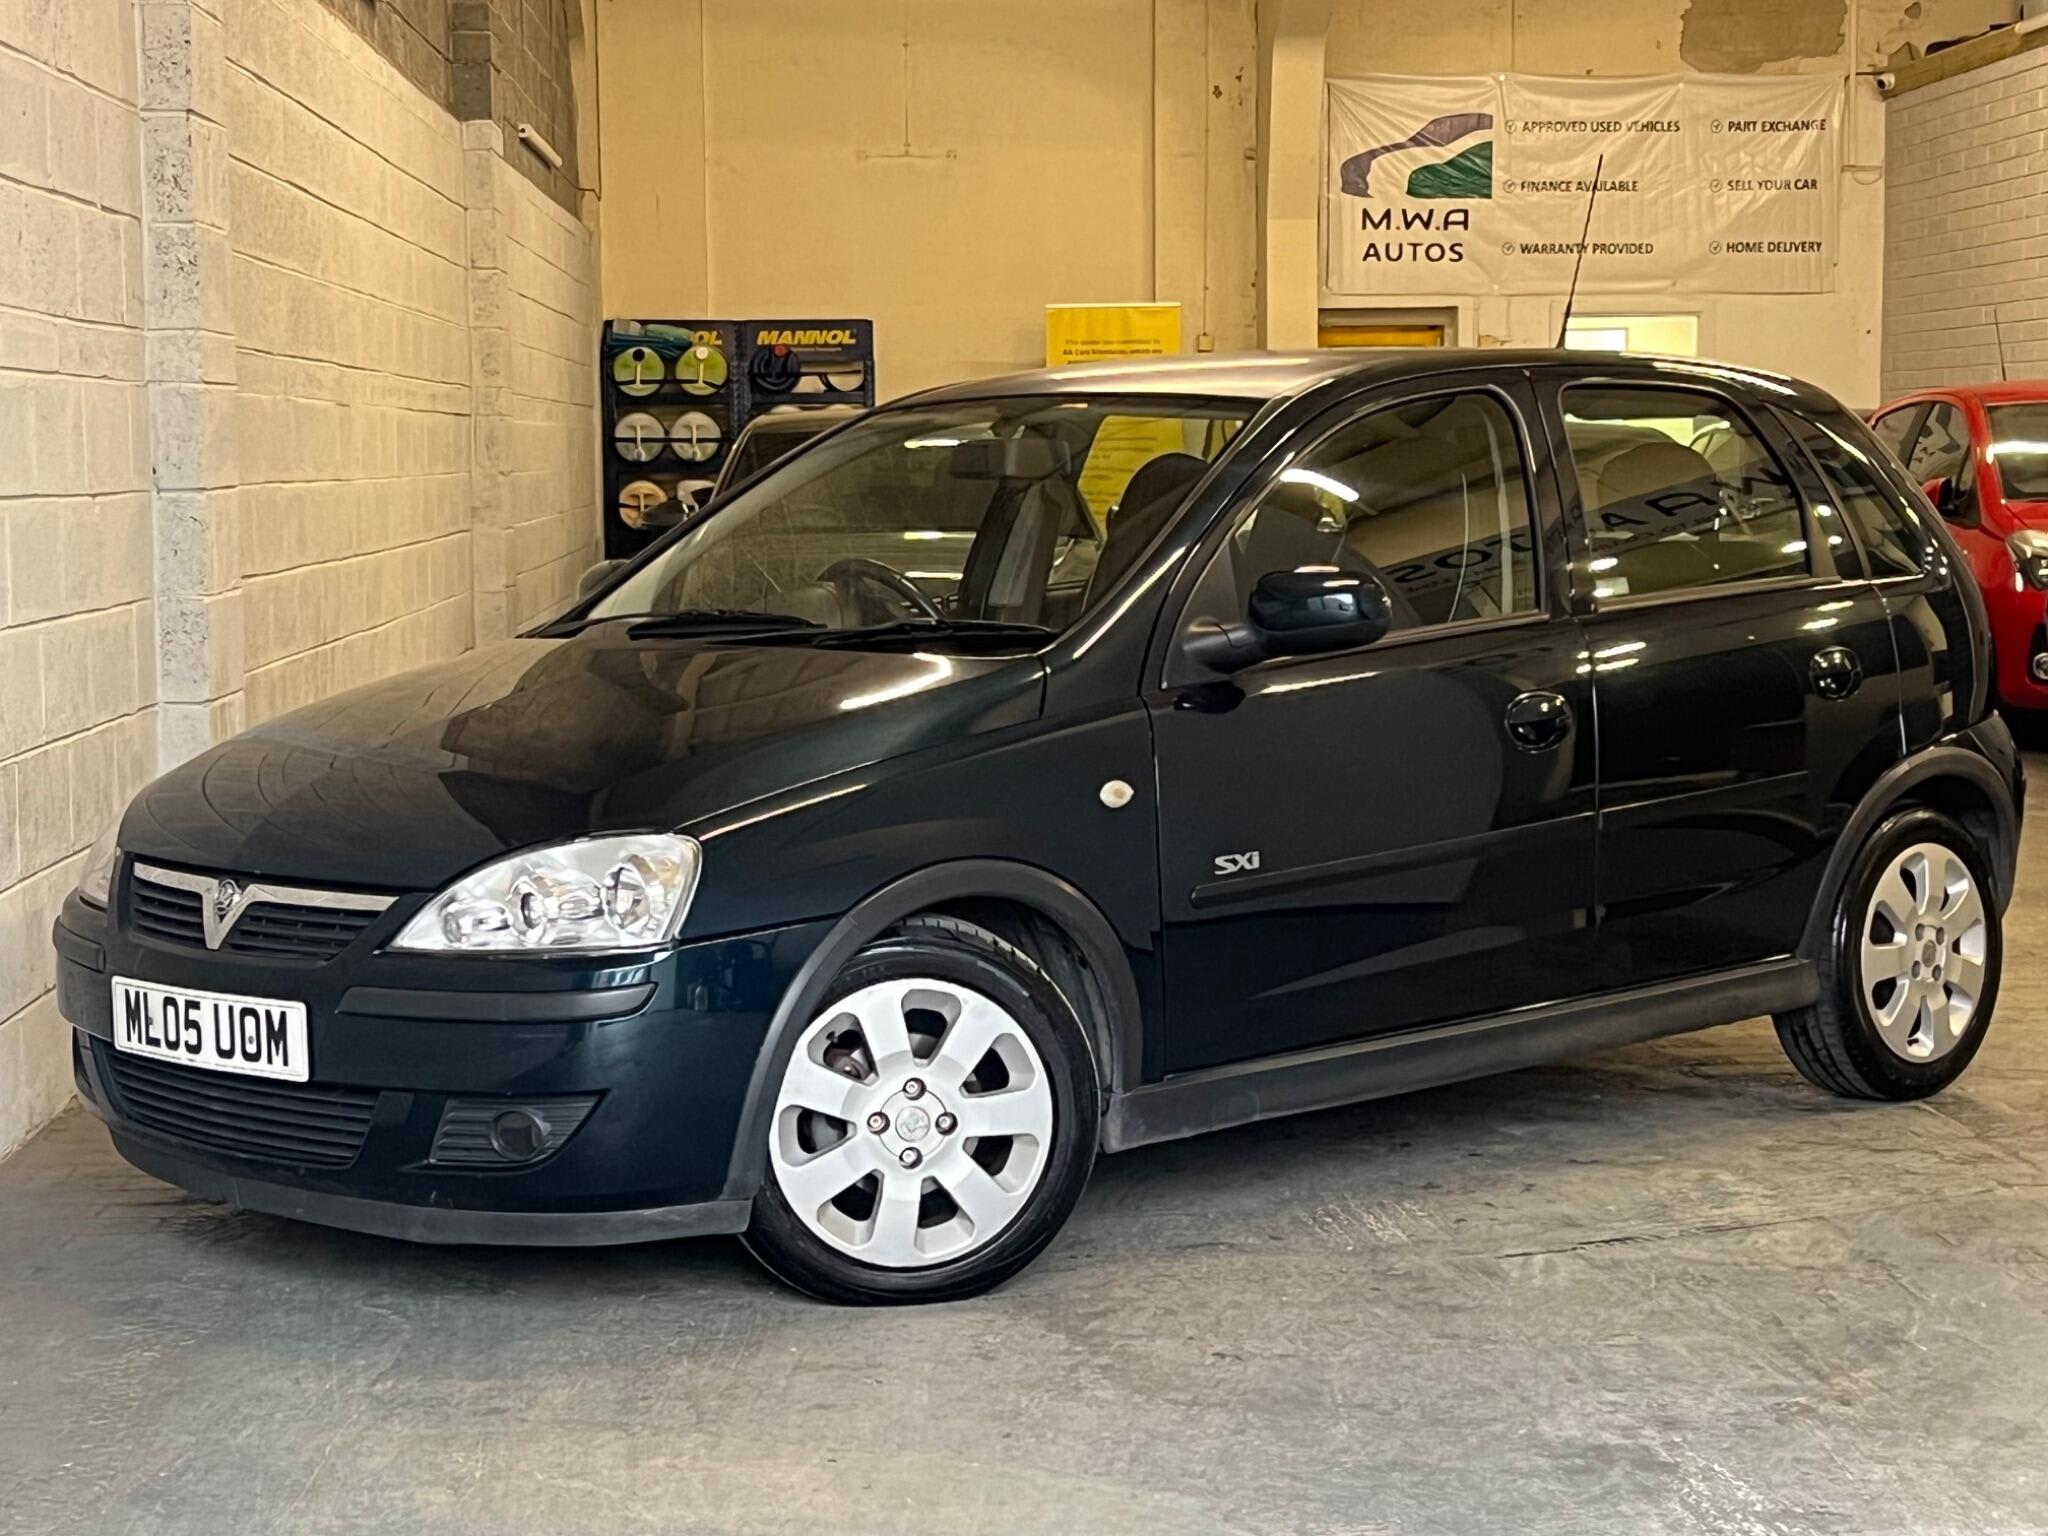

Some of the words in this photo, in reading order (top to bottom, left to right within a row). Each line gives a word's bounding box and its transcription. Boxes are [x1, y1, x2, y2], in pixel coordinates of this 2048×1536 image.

[1522, 120, 1588, 133] APPROVED
[1590, 120, 1622, 133] USED
[1626, 120, 1681, 133] VEHICLES
[1728, 120, 1757, 132] PART
[1761, 119, 1826, 132] EXCHANGE
[1520, 180, 1573, 192] FINANCE
[1575, 180, 1639, 192] AVAILABLE
[1727, 179, 1753, 191] SELL
[1756, 179, 1791, 191] YOUR
[1794, 178, 1818, 190] CAR
[1361, 207, 1469, 231] M.W.A
[1361, 242, 1464, 262] AUTOS
[1520, 242, 1590, 255] WARRANTY
[1592, 242, 1655, 254] PROVIDED
[1726, 241, 1764, 253] HOME
[1767, 241, 1822, 253] DELIVERY
[756, 330, 857, 346] MANNOL
[124, 988, 203, 1055] ML05
[213, 1003, 289, 1067] UOM
